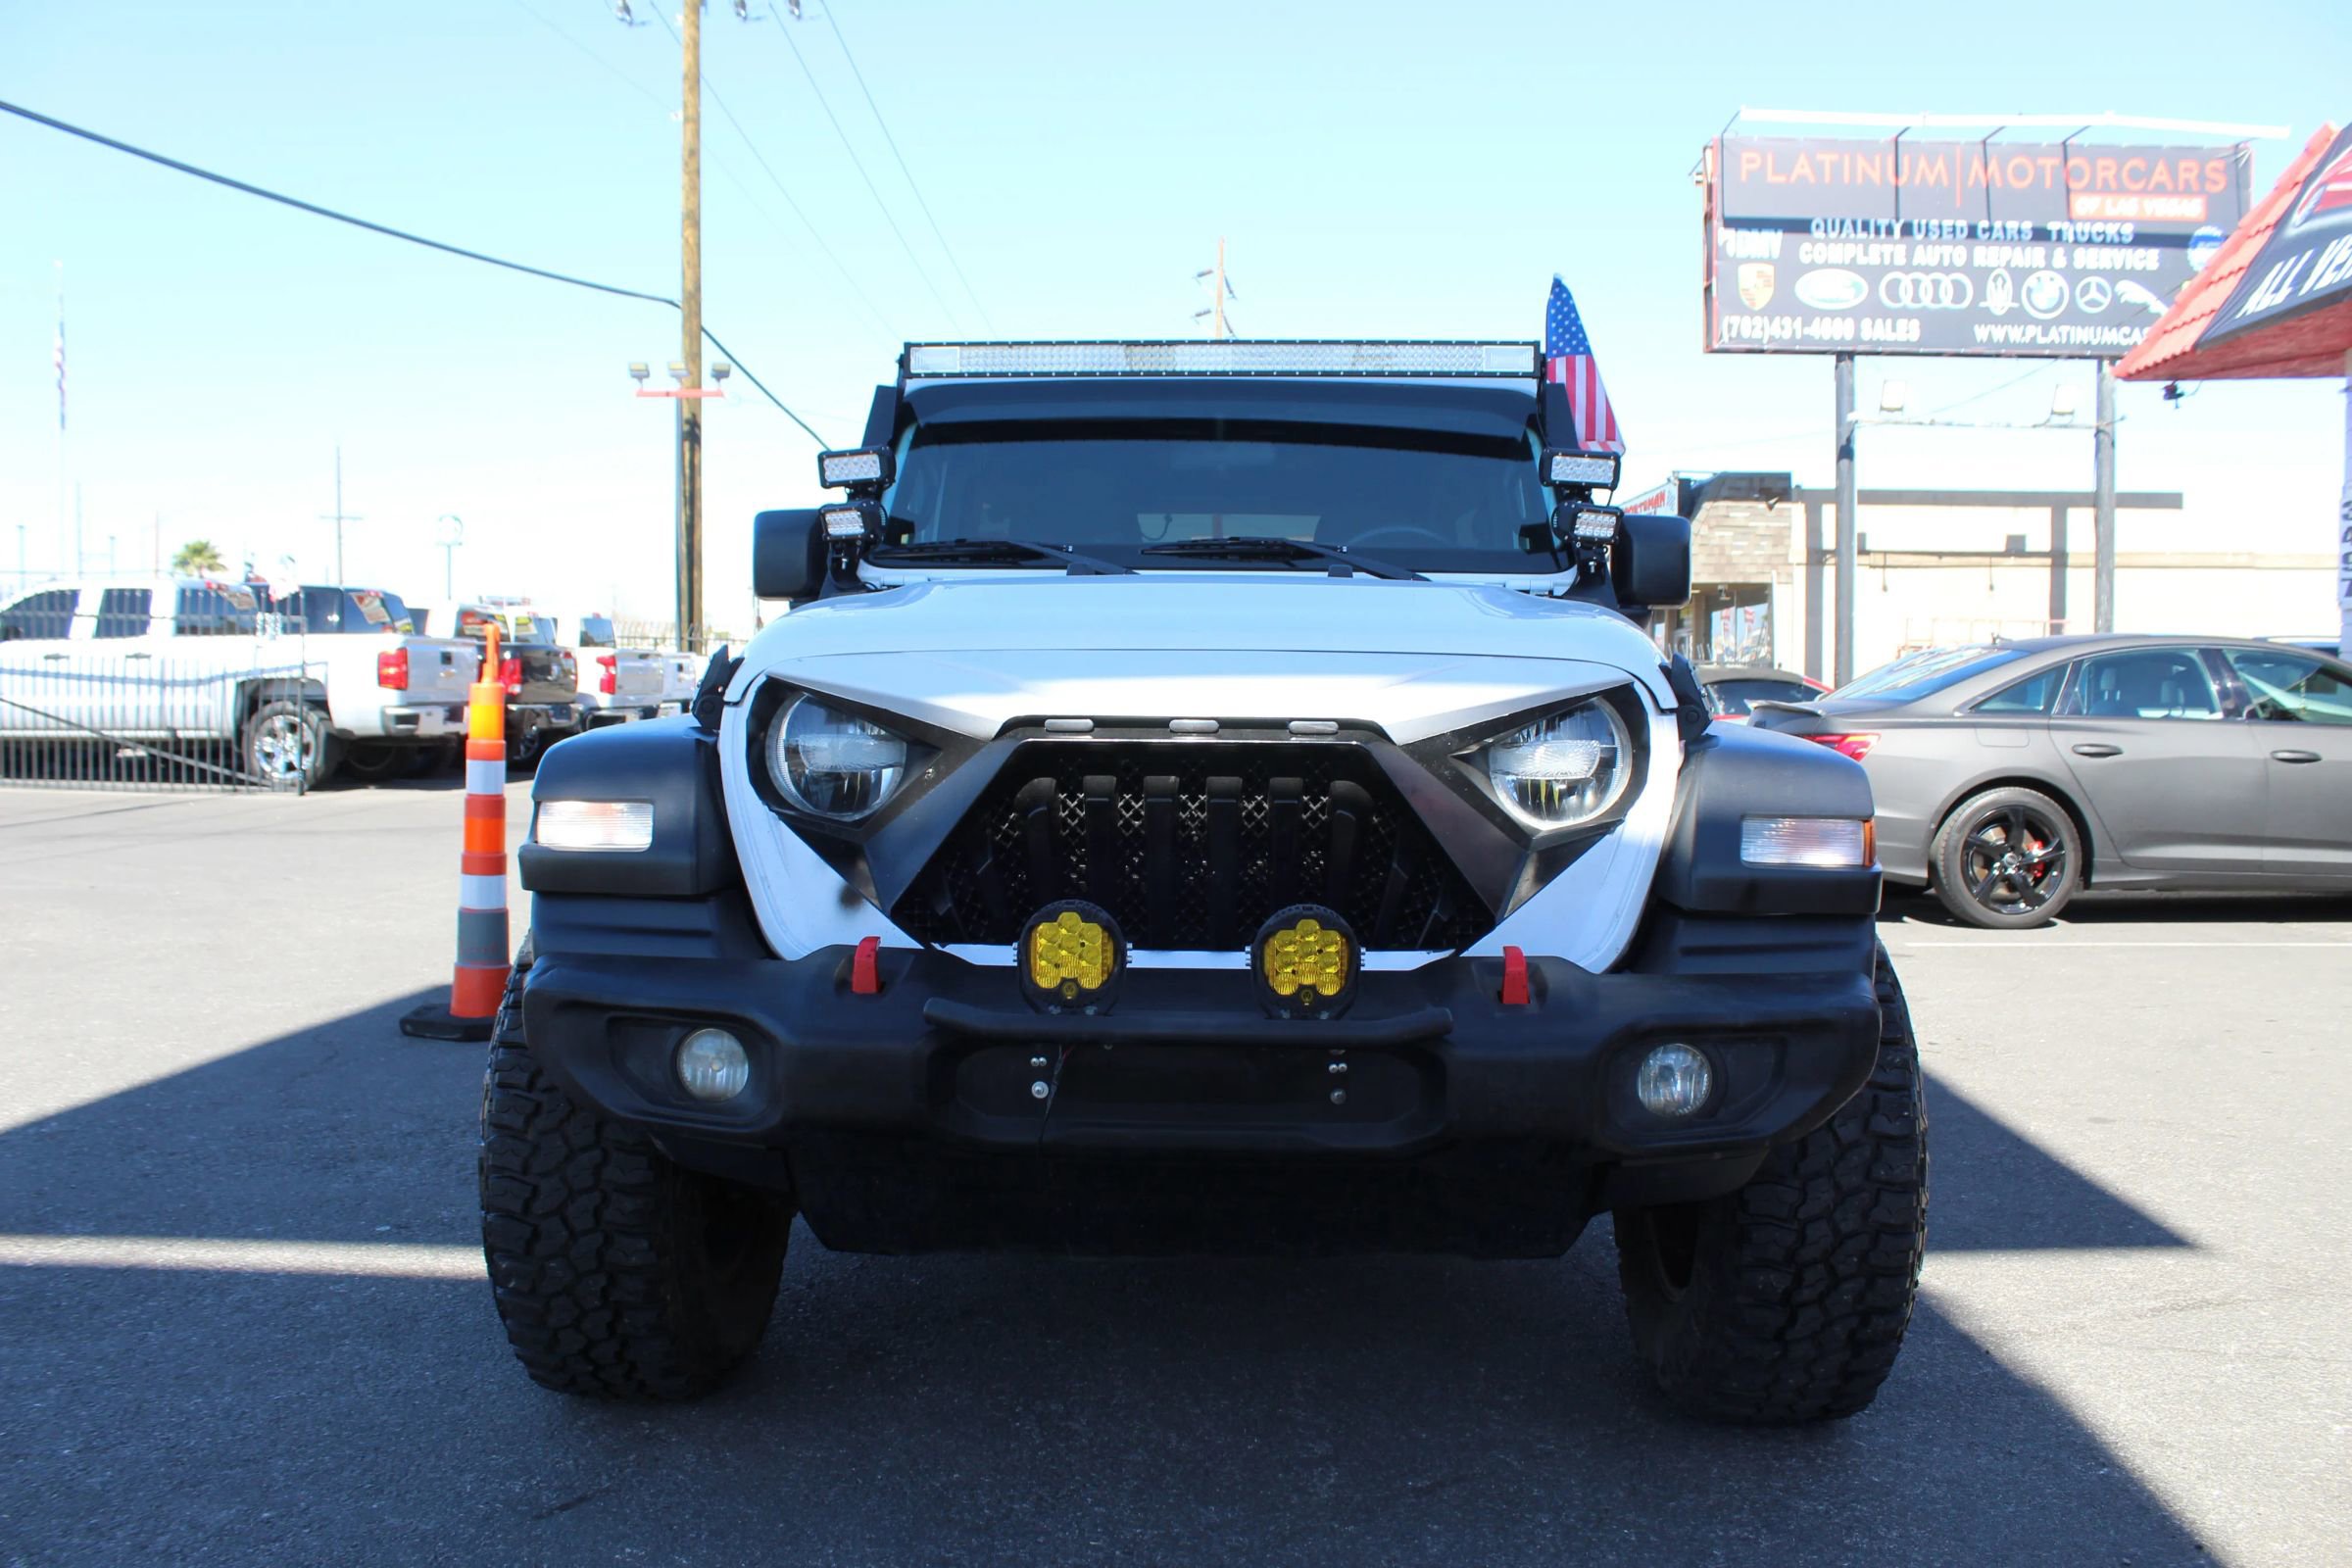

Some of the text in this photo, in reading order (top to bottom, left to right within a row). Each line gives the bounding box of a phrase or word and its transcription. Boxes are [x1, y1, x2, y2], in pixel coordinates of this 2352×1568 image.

[1740, 151, 2228, 194] PLATINUM MOTORCARS
[1811, 219, 2135, 244] QUALITY USED CARS TRUCKS
[1799, 242, 1906, 267] COMPLETE
[1912, 244, 1968, 268] AUTO
[1973, 246, 2046, 269] REPAIR
[2051, 248, 2068, 269] &
[2073, 248, 2160, 270] SERVICE
[2234, 249, 2314, 319] ALL
[1860, 318, 1921, 342] SALES
